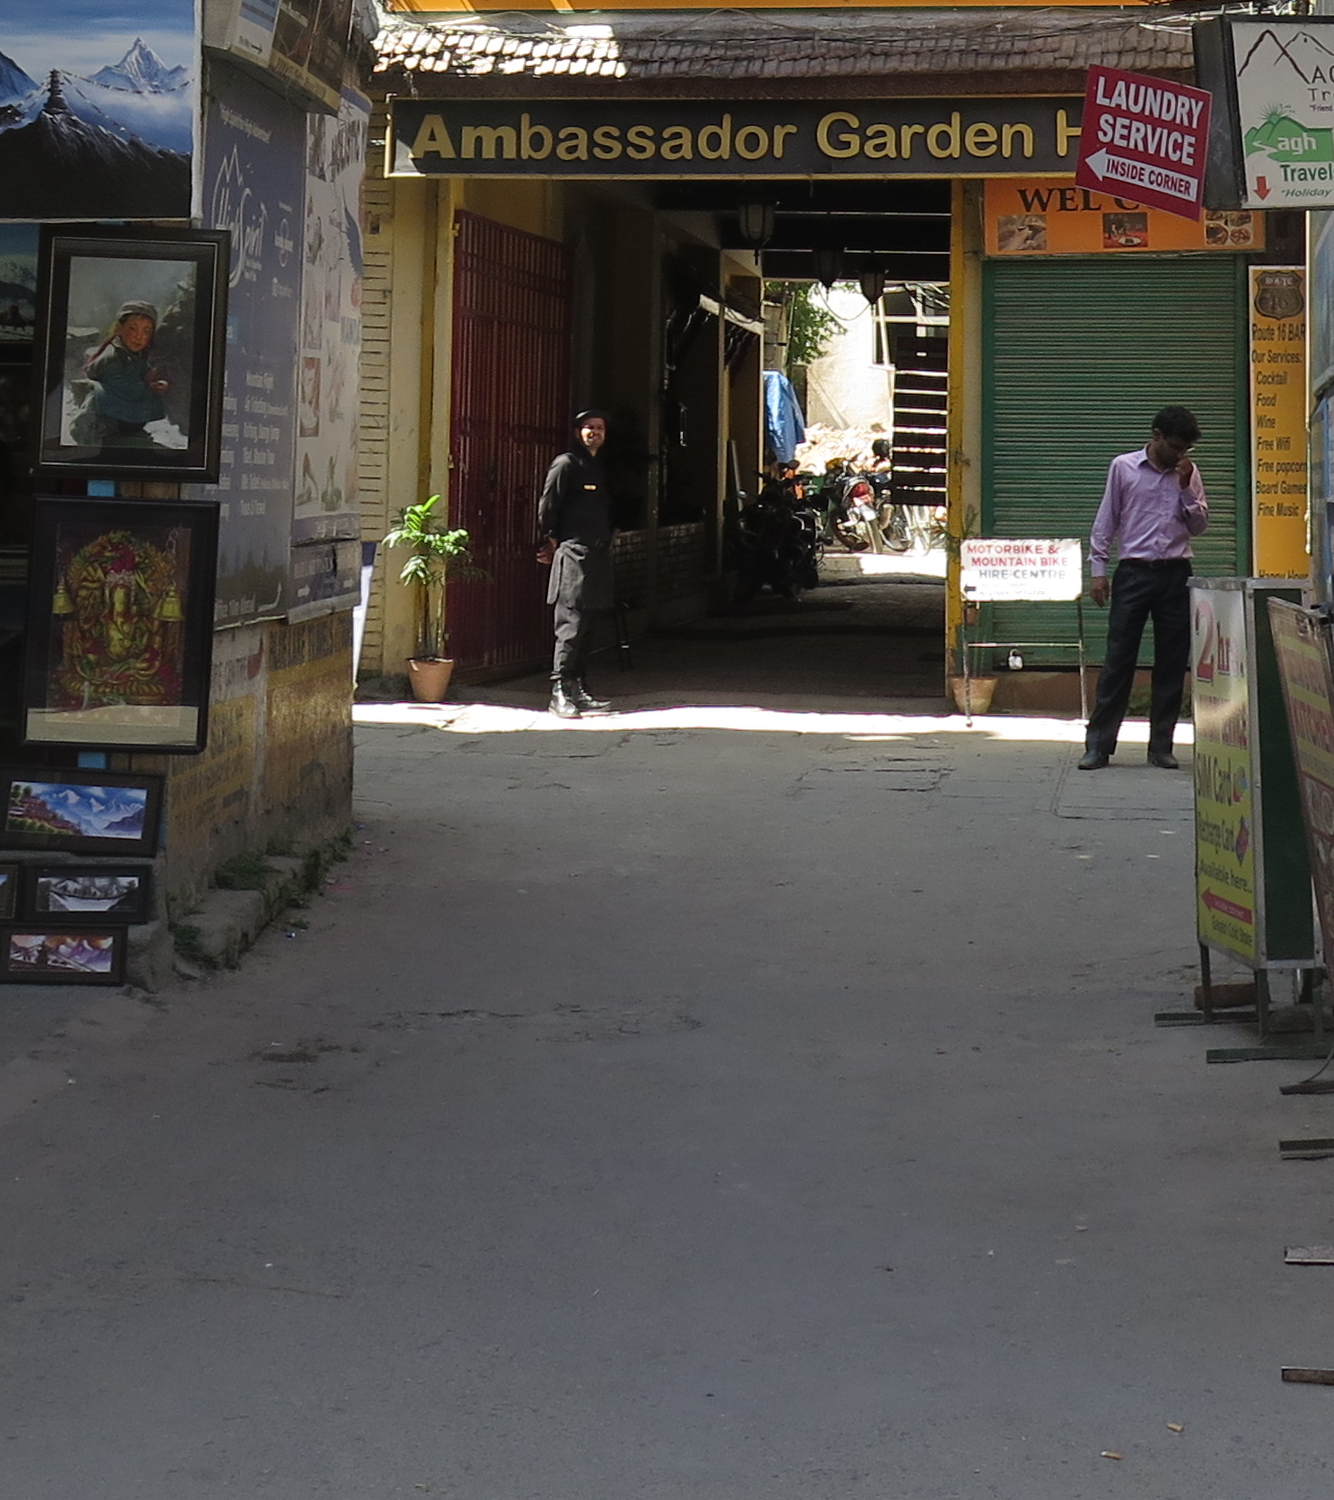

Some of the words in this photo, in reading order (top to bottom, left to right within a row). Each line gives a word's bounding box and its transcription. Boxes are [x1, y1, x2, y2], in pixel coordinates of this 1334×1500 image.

[1095, 75, 1205, 130] LAUNDRY
[409, 111, 799, 162] Ambassador
[817, 110, 1034, 160] Garden
[1097, 113, 1198, 167] SERVICE
[1105, 158, 1147, 184] INSIDE
[1147, 170, 1192, 198] CORNER
[1255, 370, 1289, 386] Cocktail
[1255, 393, 1277, 408] Food
[970, 556, 1037, 568] MOUNTAIN
